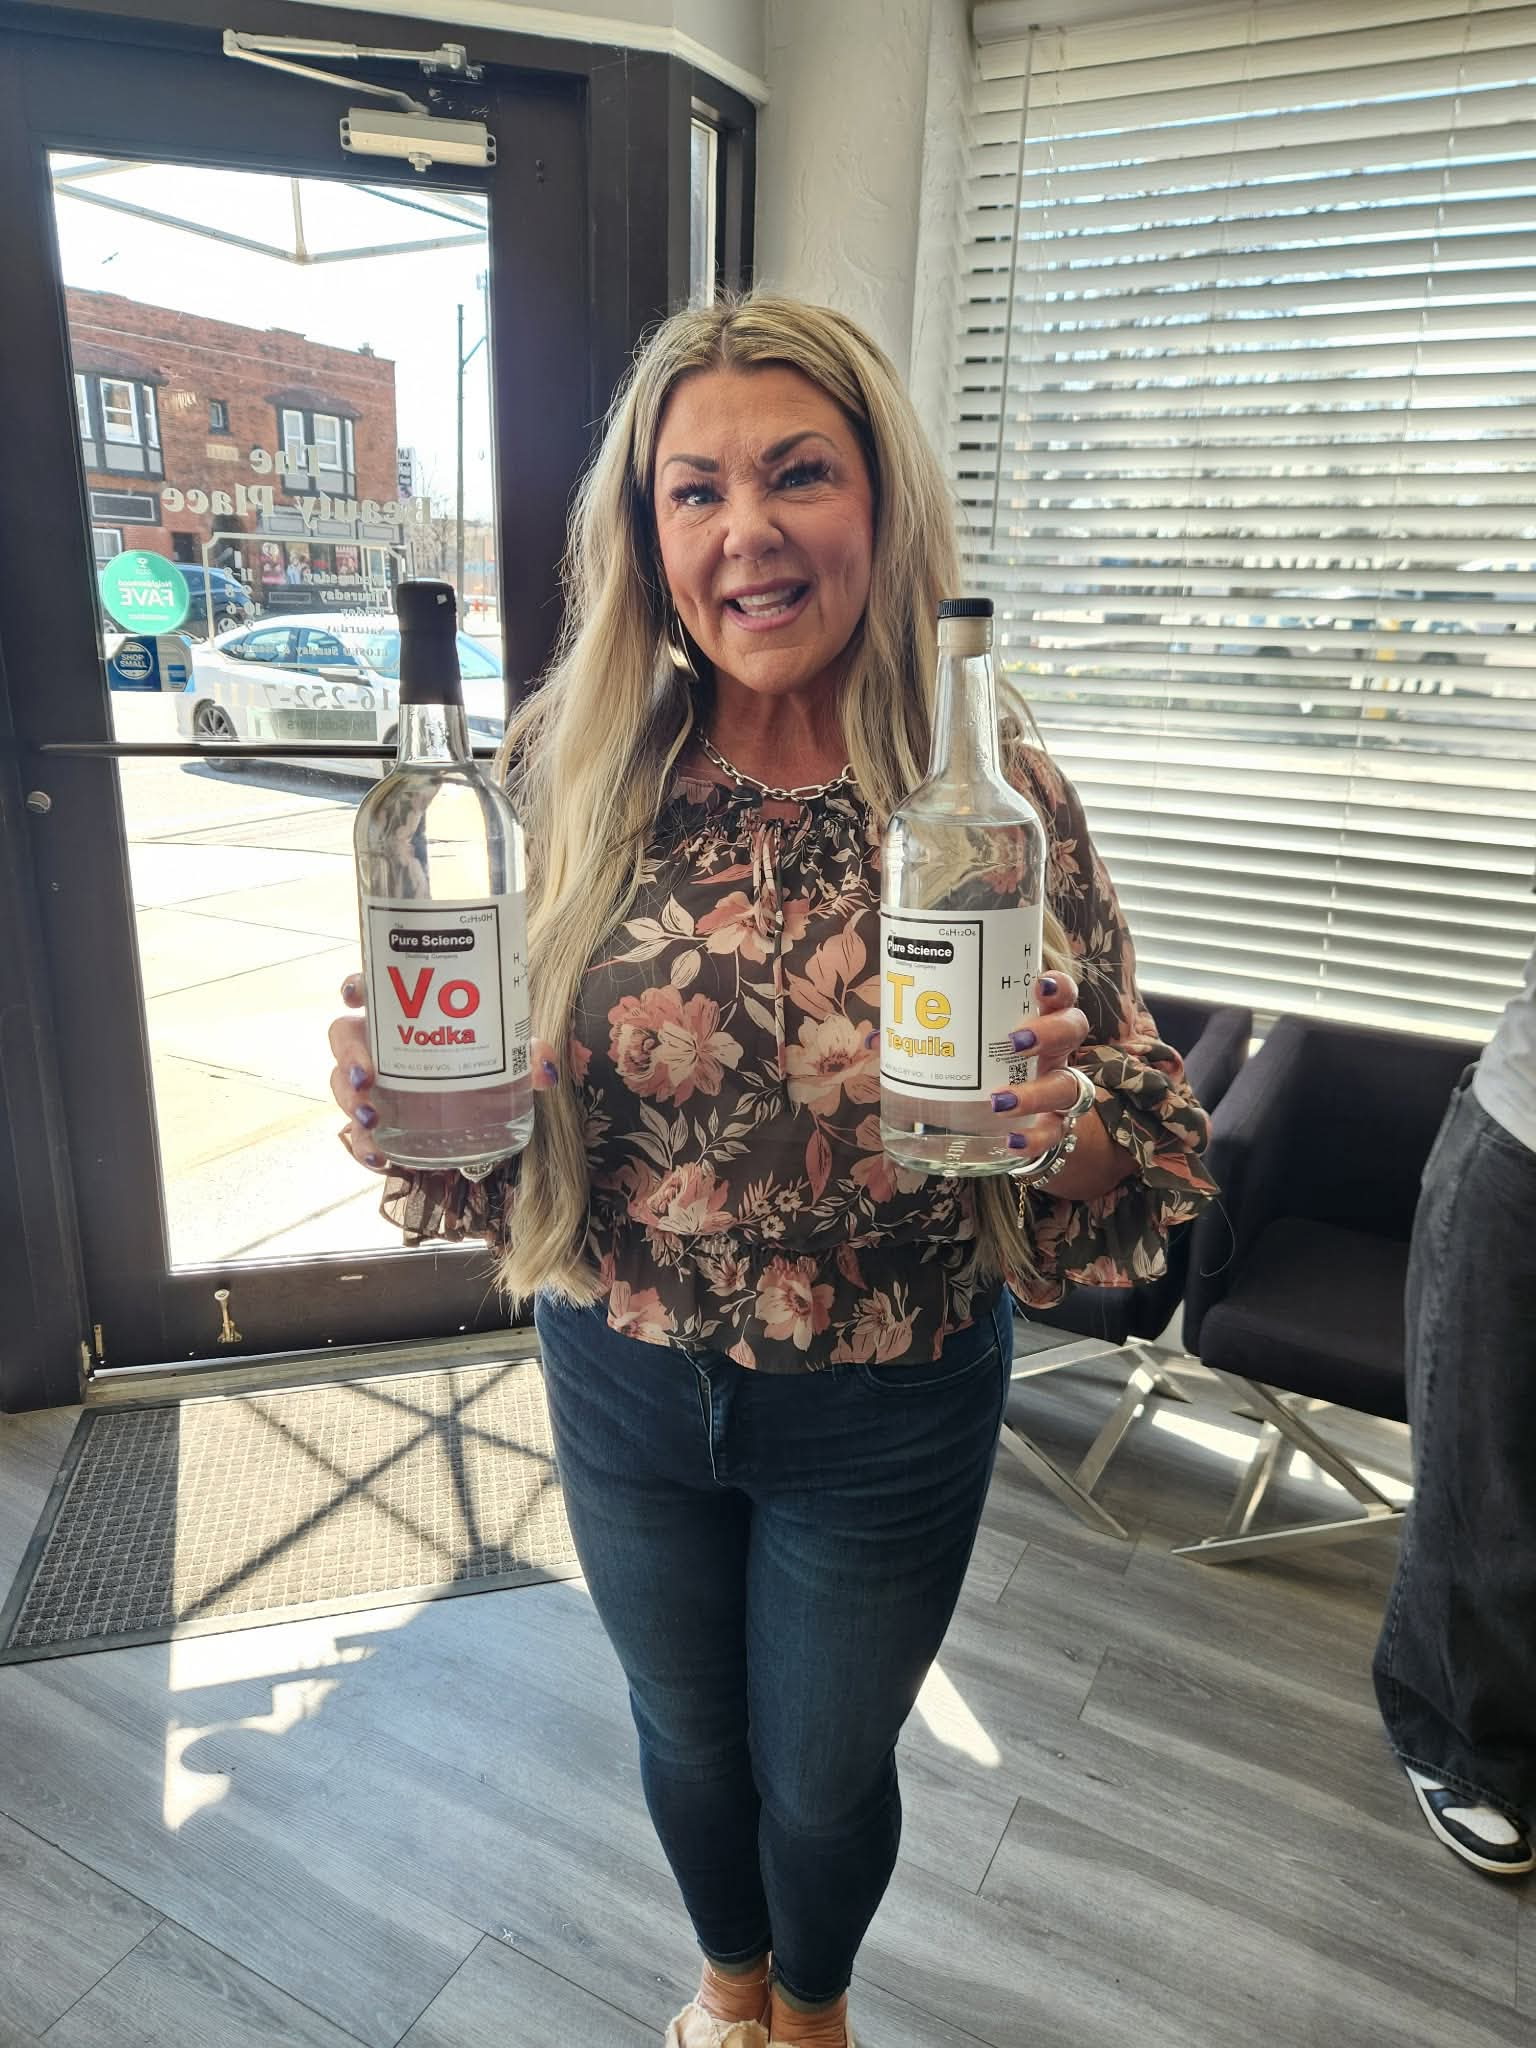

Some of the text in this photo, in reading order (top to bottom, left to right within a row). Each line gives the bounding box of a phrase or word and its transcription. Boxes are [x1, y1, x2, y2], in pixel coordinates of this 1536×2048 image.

[120, 660, 147, 669] SMALL
[121, 653, 145, 662] SHOP
[391, 934, 473, 946] Pure Science
[888, 940, 952, 957] Pure Science
[387, 965, 480, 1019] Vo
[887, 971, 951, 1030] Te
[397, 1024, 477, 1046] Vodka
[886, 1027, 955, 1057] Tequila
